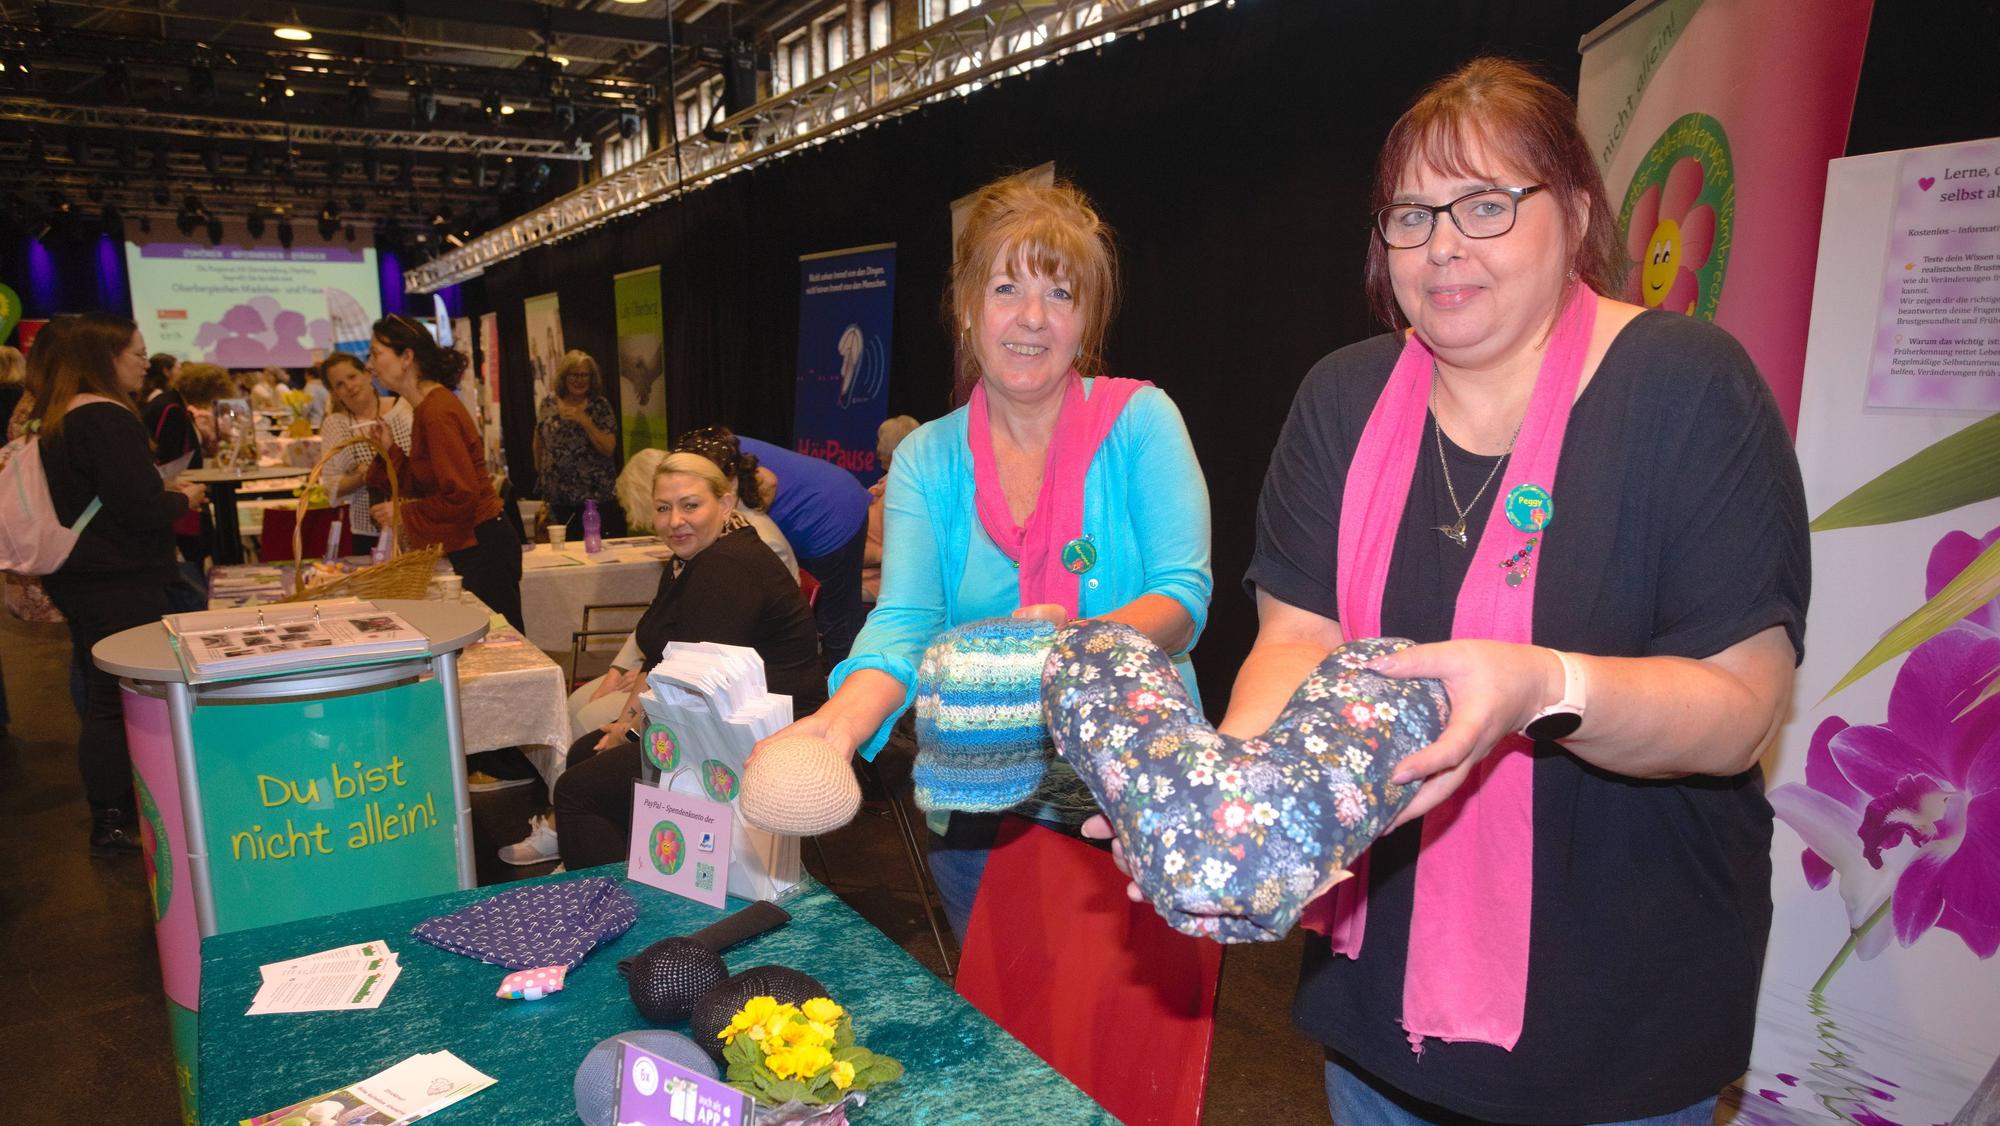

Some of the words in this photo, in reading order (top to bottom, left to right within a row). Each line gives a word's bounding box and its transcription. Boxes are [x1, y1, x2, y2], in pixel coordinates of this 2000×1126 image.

[1602, 94, 1634, 163] nicht
[1636, 10, 1675, 93] allein!
[1944, 167, 1990, 180] Lerne,
[1940, 188, 1984, 202] selbst
[1908, 228, 1949, 237] Kostenlos
[1965, 254, 1993, 262] Wissen
[1921, 265, 1971, 273] realistischen
[1931, 275, 1991, 284] Veränderungen
[1916, 298, 1940, 306] zeigen
[1897, 317, 1960, 326] Brustgesundheit
[1909, 337, 1937, 345] Warum
[1938, 337, 1952, 345] das
[1954, 337, 1984, 346] wichtig
[1893, 348, 1953, 356] Früherkennung
[1892, 359, 1941, 367] Regelmäßige
[1890, 368, 1915, 376] helfen,
[1917, 368, 1976, 378] Veränderungen
[1979, 368, 1996, 377] früh
[797, 438, 875, 471] HörPause
[1518, 496, 1543, 508] Peggy
[256, 774, 321, 807] Du
[331, 755, 407, 799] bist
[643, 798, 662, 809] PayPal
[665, 804, 704, 821] Spendenkonto
[704, 815, 715, 824] der
[231, 818, 334, 861] nicht
[347, 791, 439, 849] allein!
[697, 1106, 721, 1126] APP
